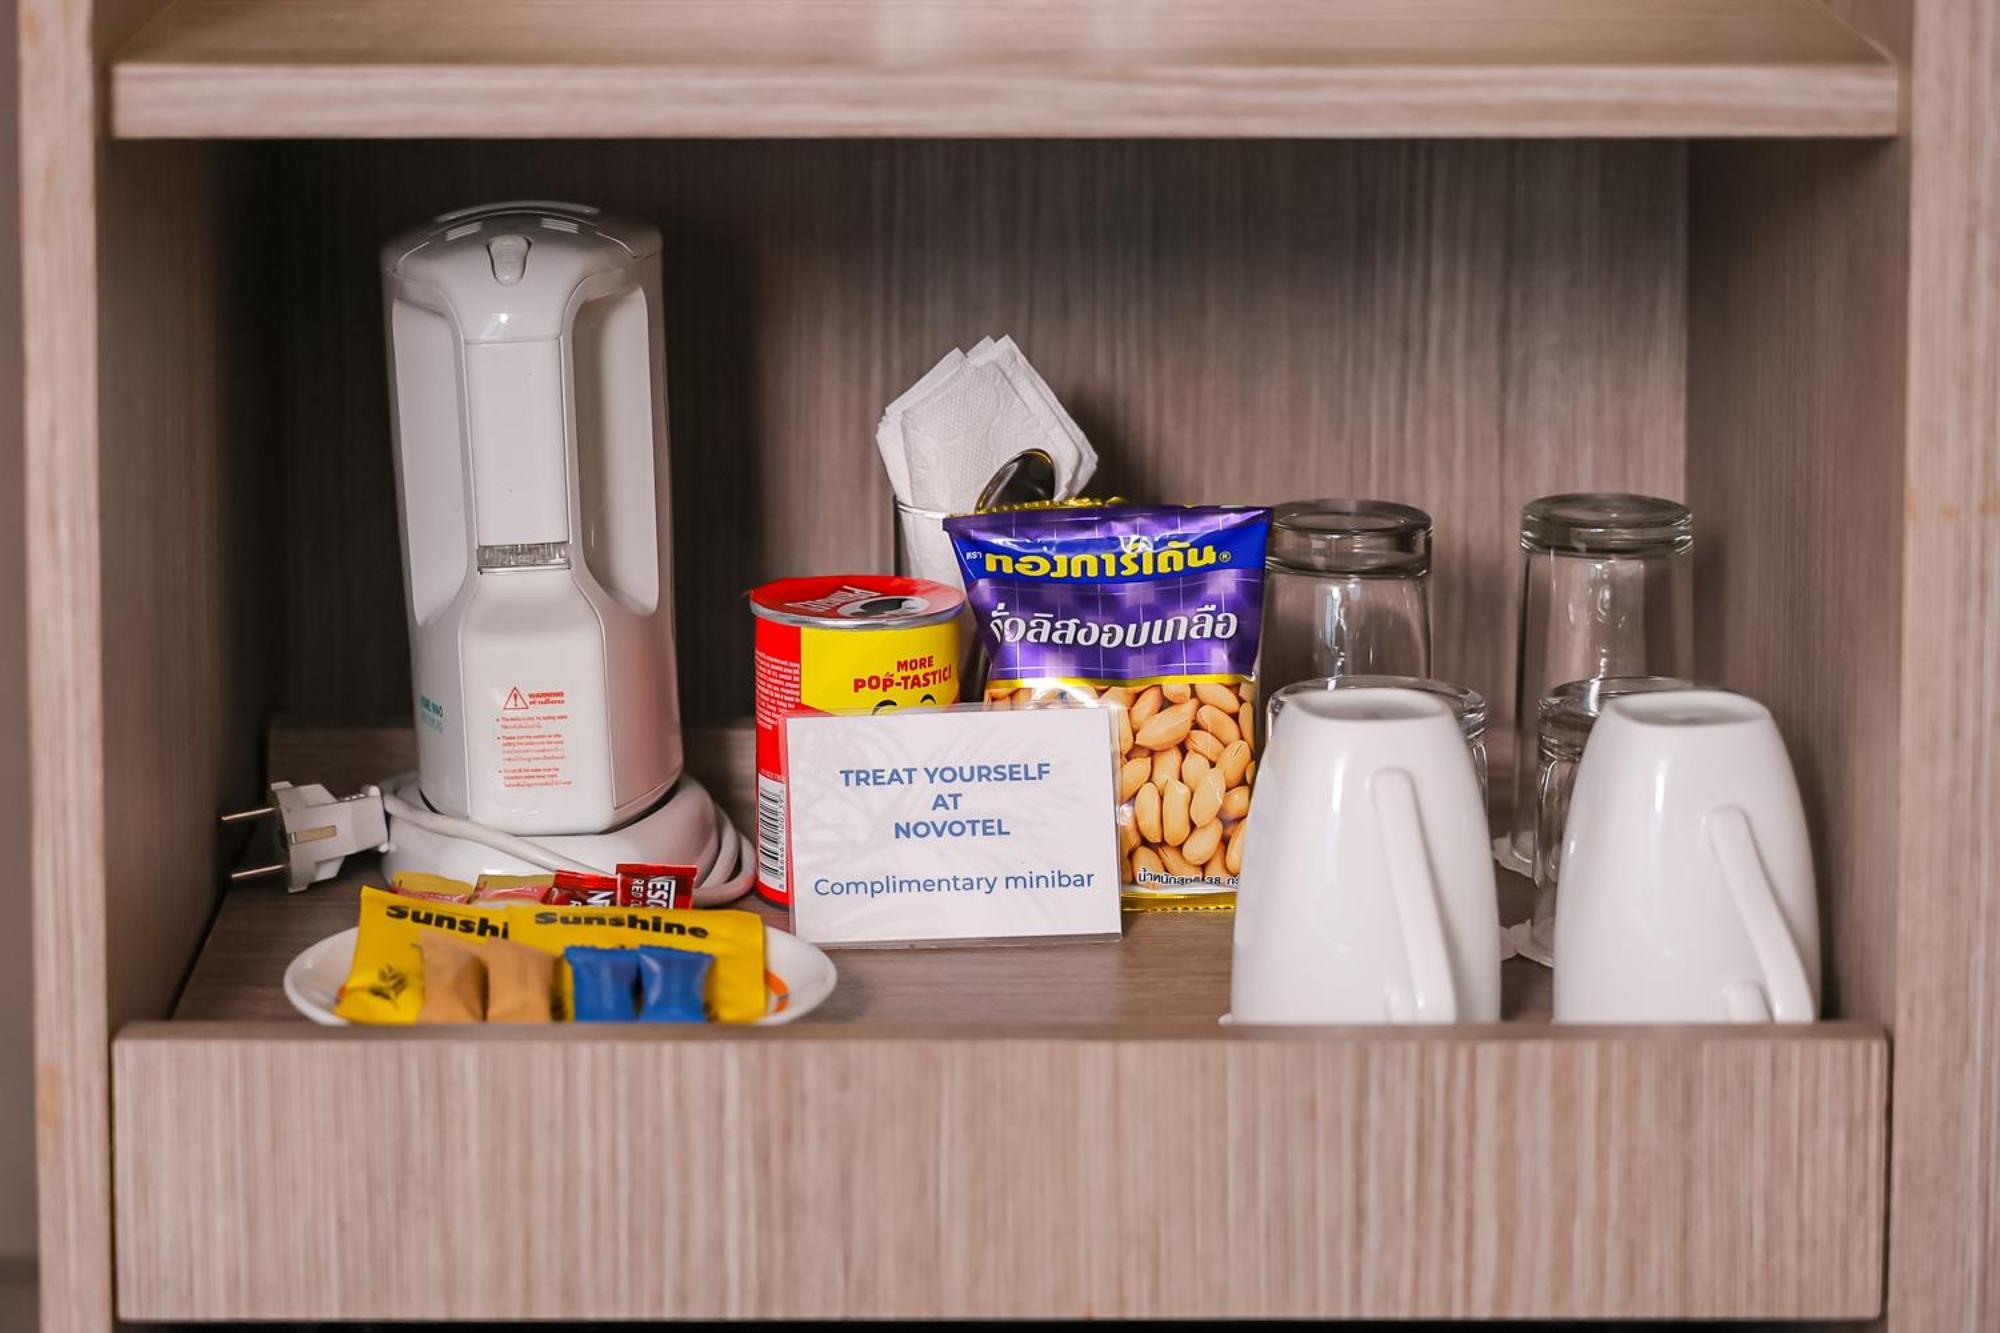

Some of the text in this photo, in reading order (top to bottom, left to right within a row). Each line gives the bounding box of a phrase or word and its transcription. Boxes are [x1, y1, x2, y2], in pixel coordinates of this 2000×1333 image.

[896, 655, 934, 672] MORE
[839, 763, 1051, 787] TREAT YOURSELF
[931, 793, 962, 811] AT
[894, 819, 1010, 839] NOVOTEL
[814, 870, 1096, 898] Complimentary minibar
[1206, 876, 1221, 884] 38
[386, 905, 509, 939] Sunshi
[534, 911, 709, 939] Sunshine
